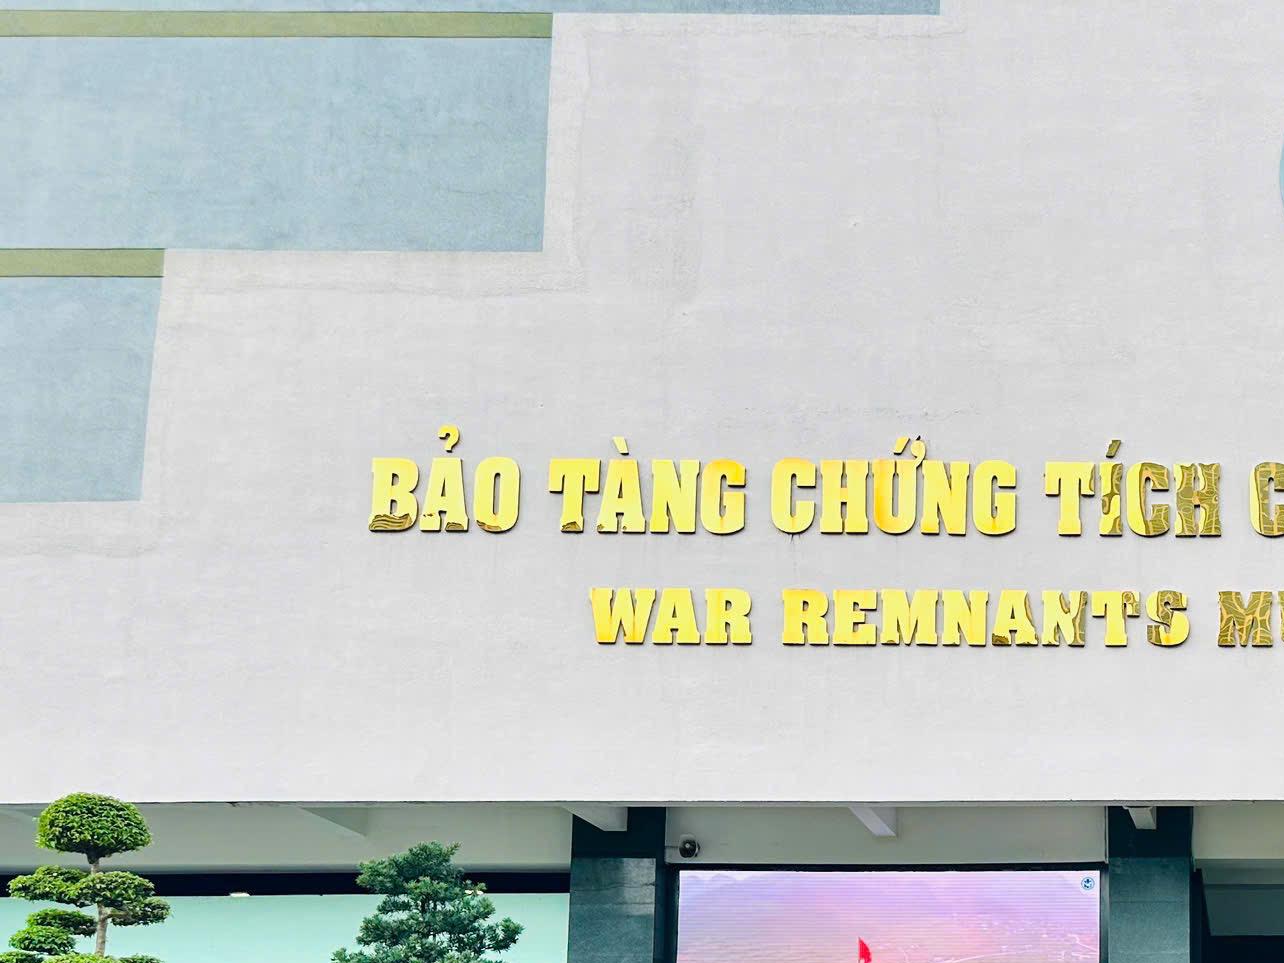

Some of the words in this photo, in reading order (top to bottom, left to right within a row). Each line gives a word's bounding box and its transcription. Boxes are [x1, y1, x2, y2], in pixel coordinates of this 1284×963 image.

[368, 424, 521, 534] BẢO
[548, 437, 747, 536] TÀNG
[771, 435, 1017, 536] CHỨNG
[1044, 439, 1223, 538] TÍCH
[589, 587, 753, 646] WAR
[781, 588, 1192, 648] REMNANTS
